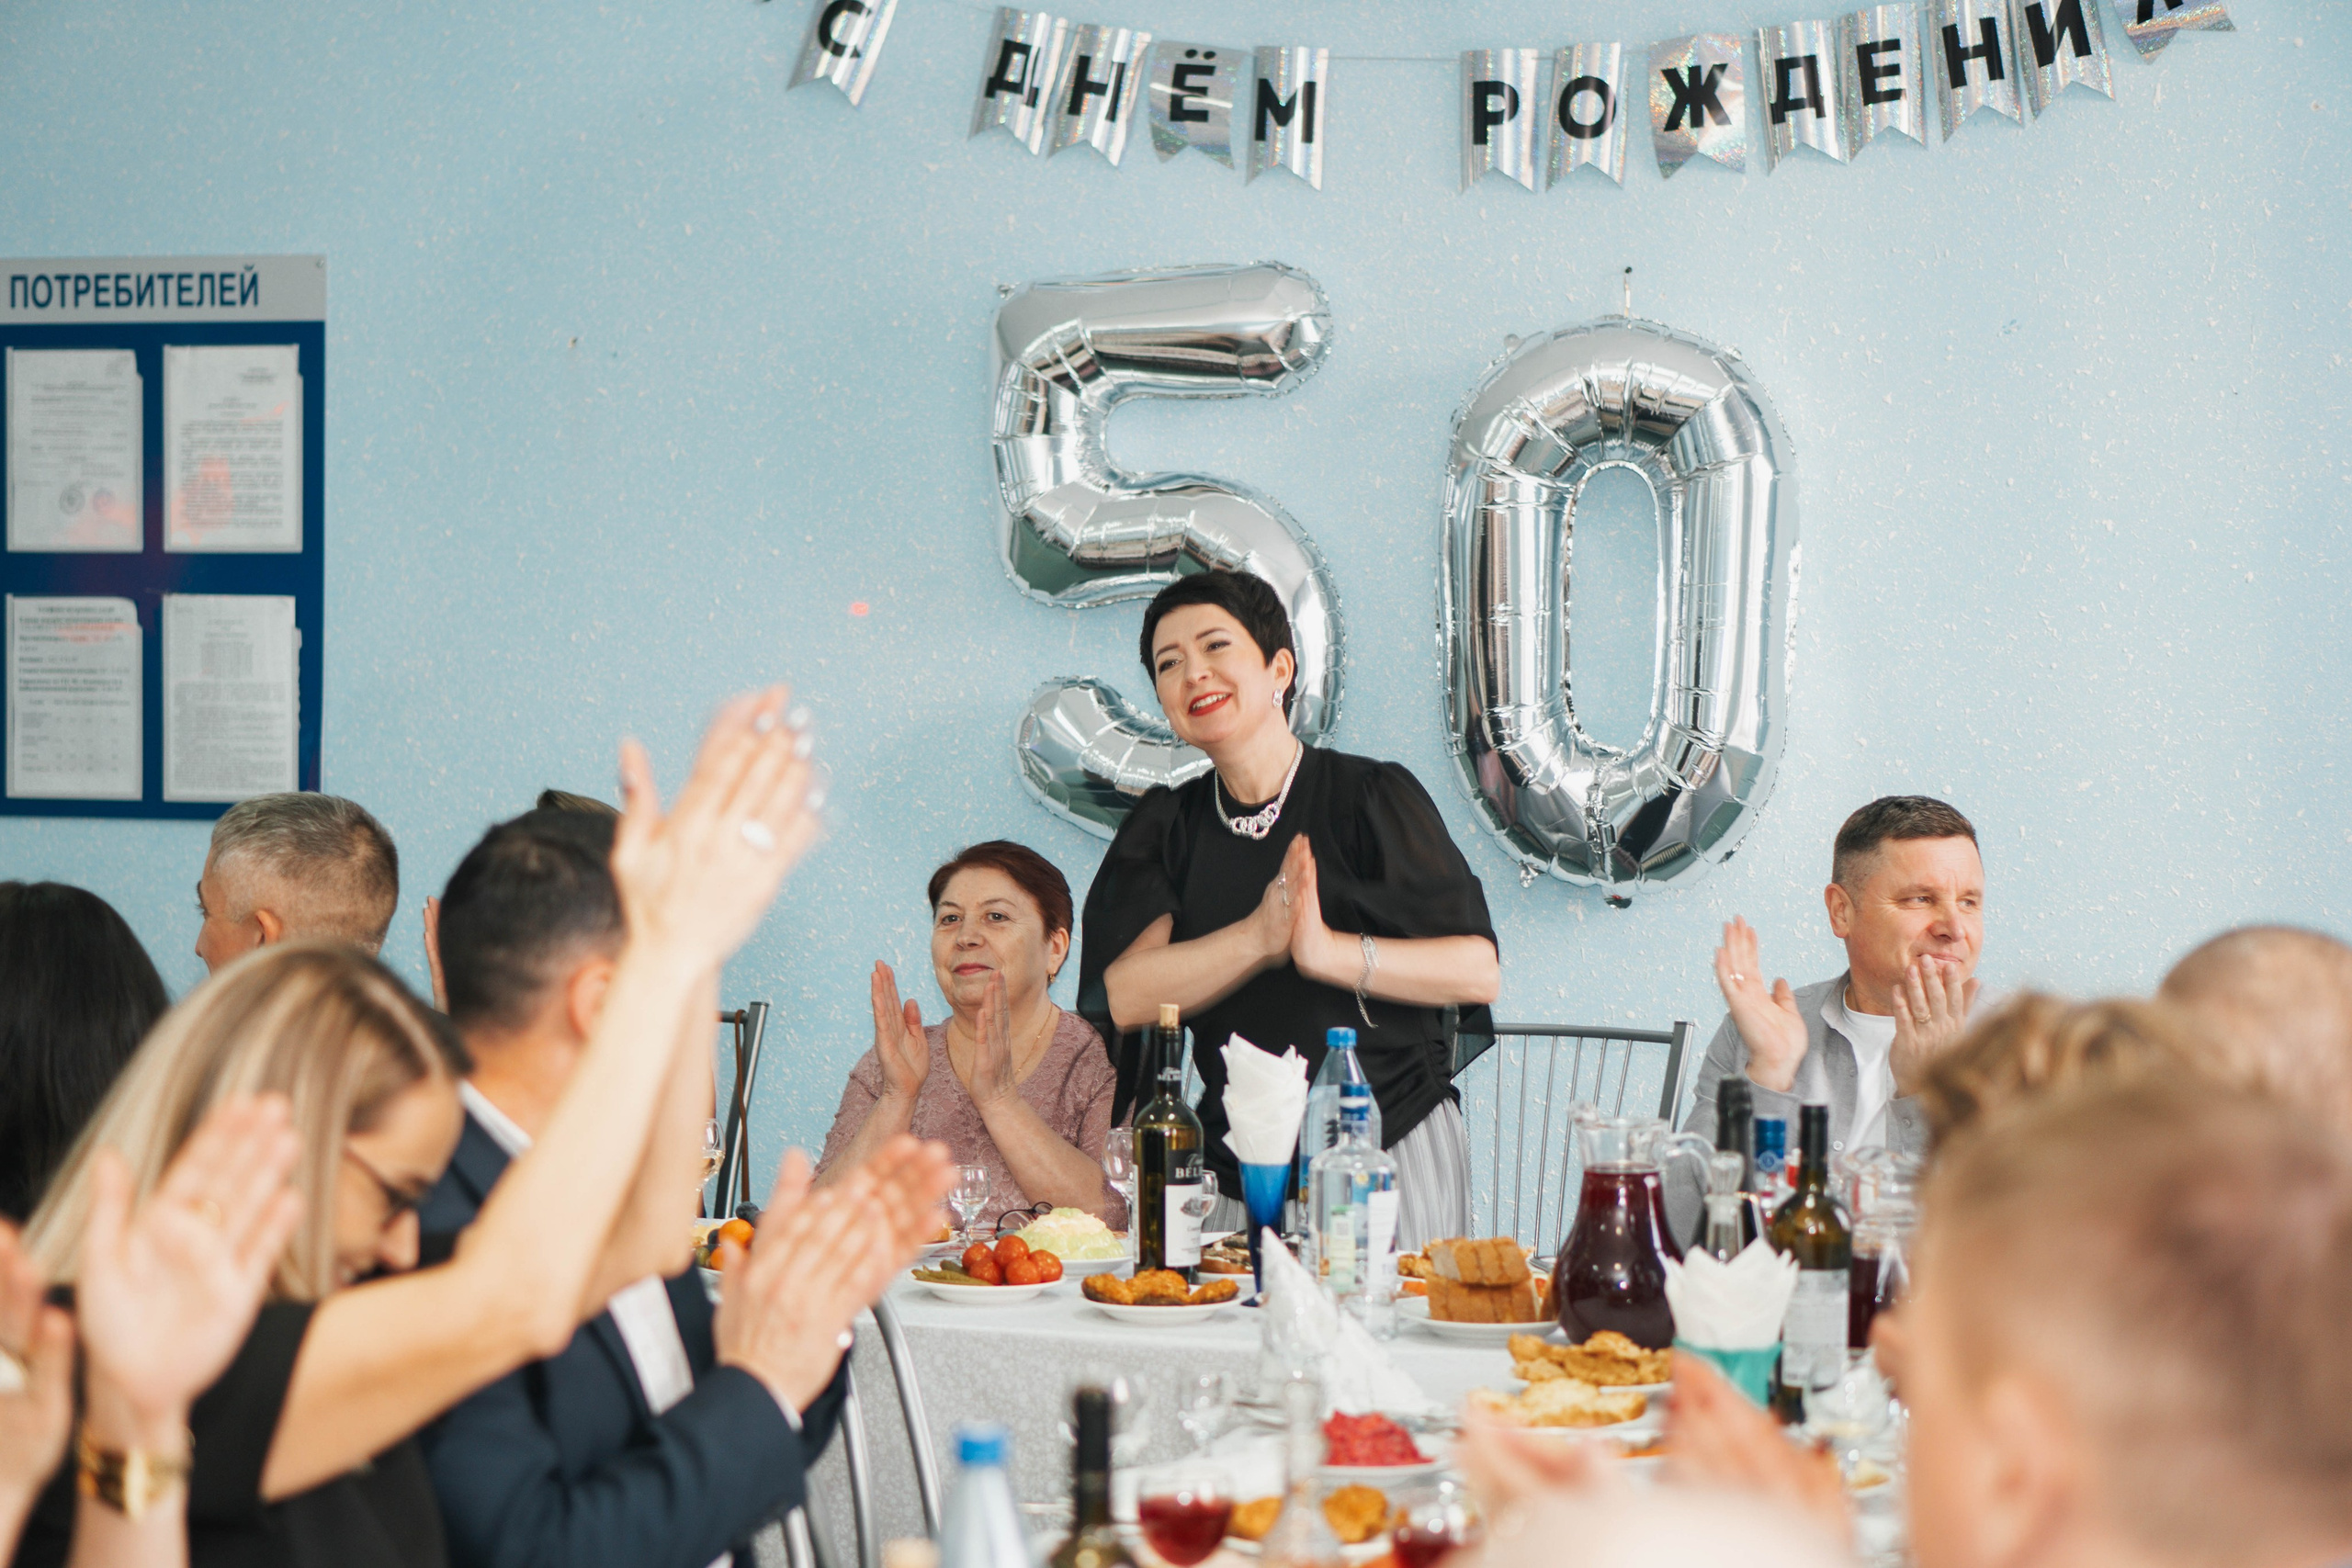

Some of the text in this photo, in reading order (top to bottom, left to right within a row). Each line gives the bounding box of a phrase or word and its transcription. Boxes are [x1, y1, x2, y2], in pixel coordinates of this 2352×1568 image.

[818, 0, 2184, 145] С ДНЁМ РОЖДЕНИ
[10, 264, 259, 310] ПОТРЕБИТЕЛЕЙ
[992, 261, 1799, 904] 50
